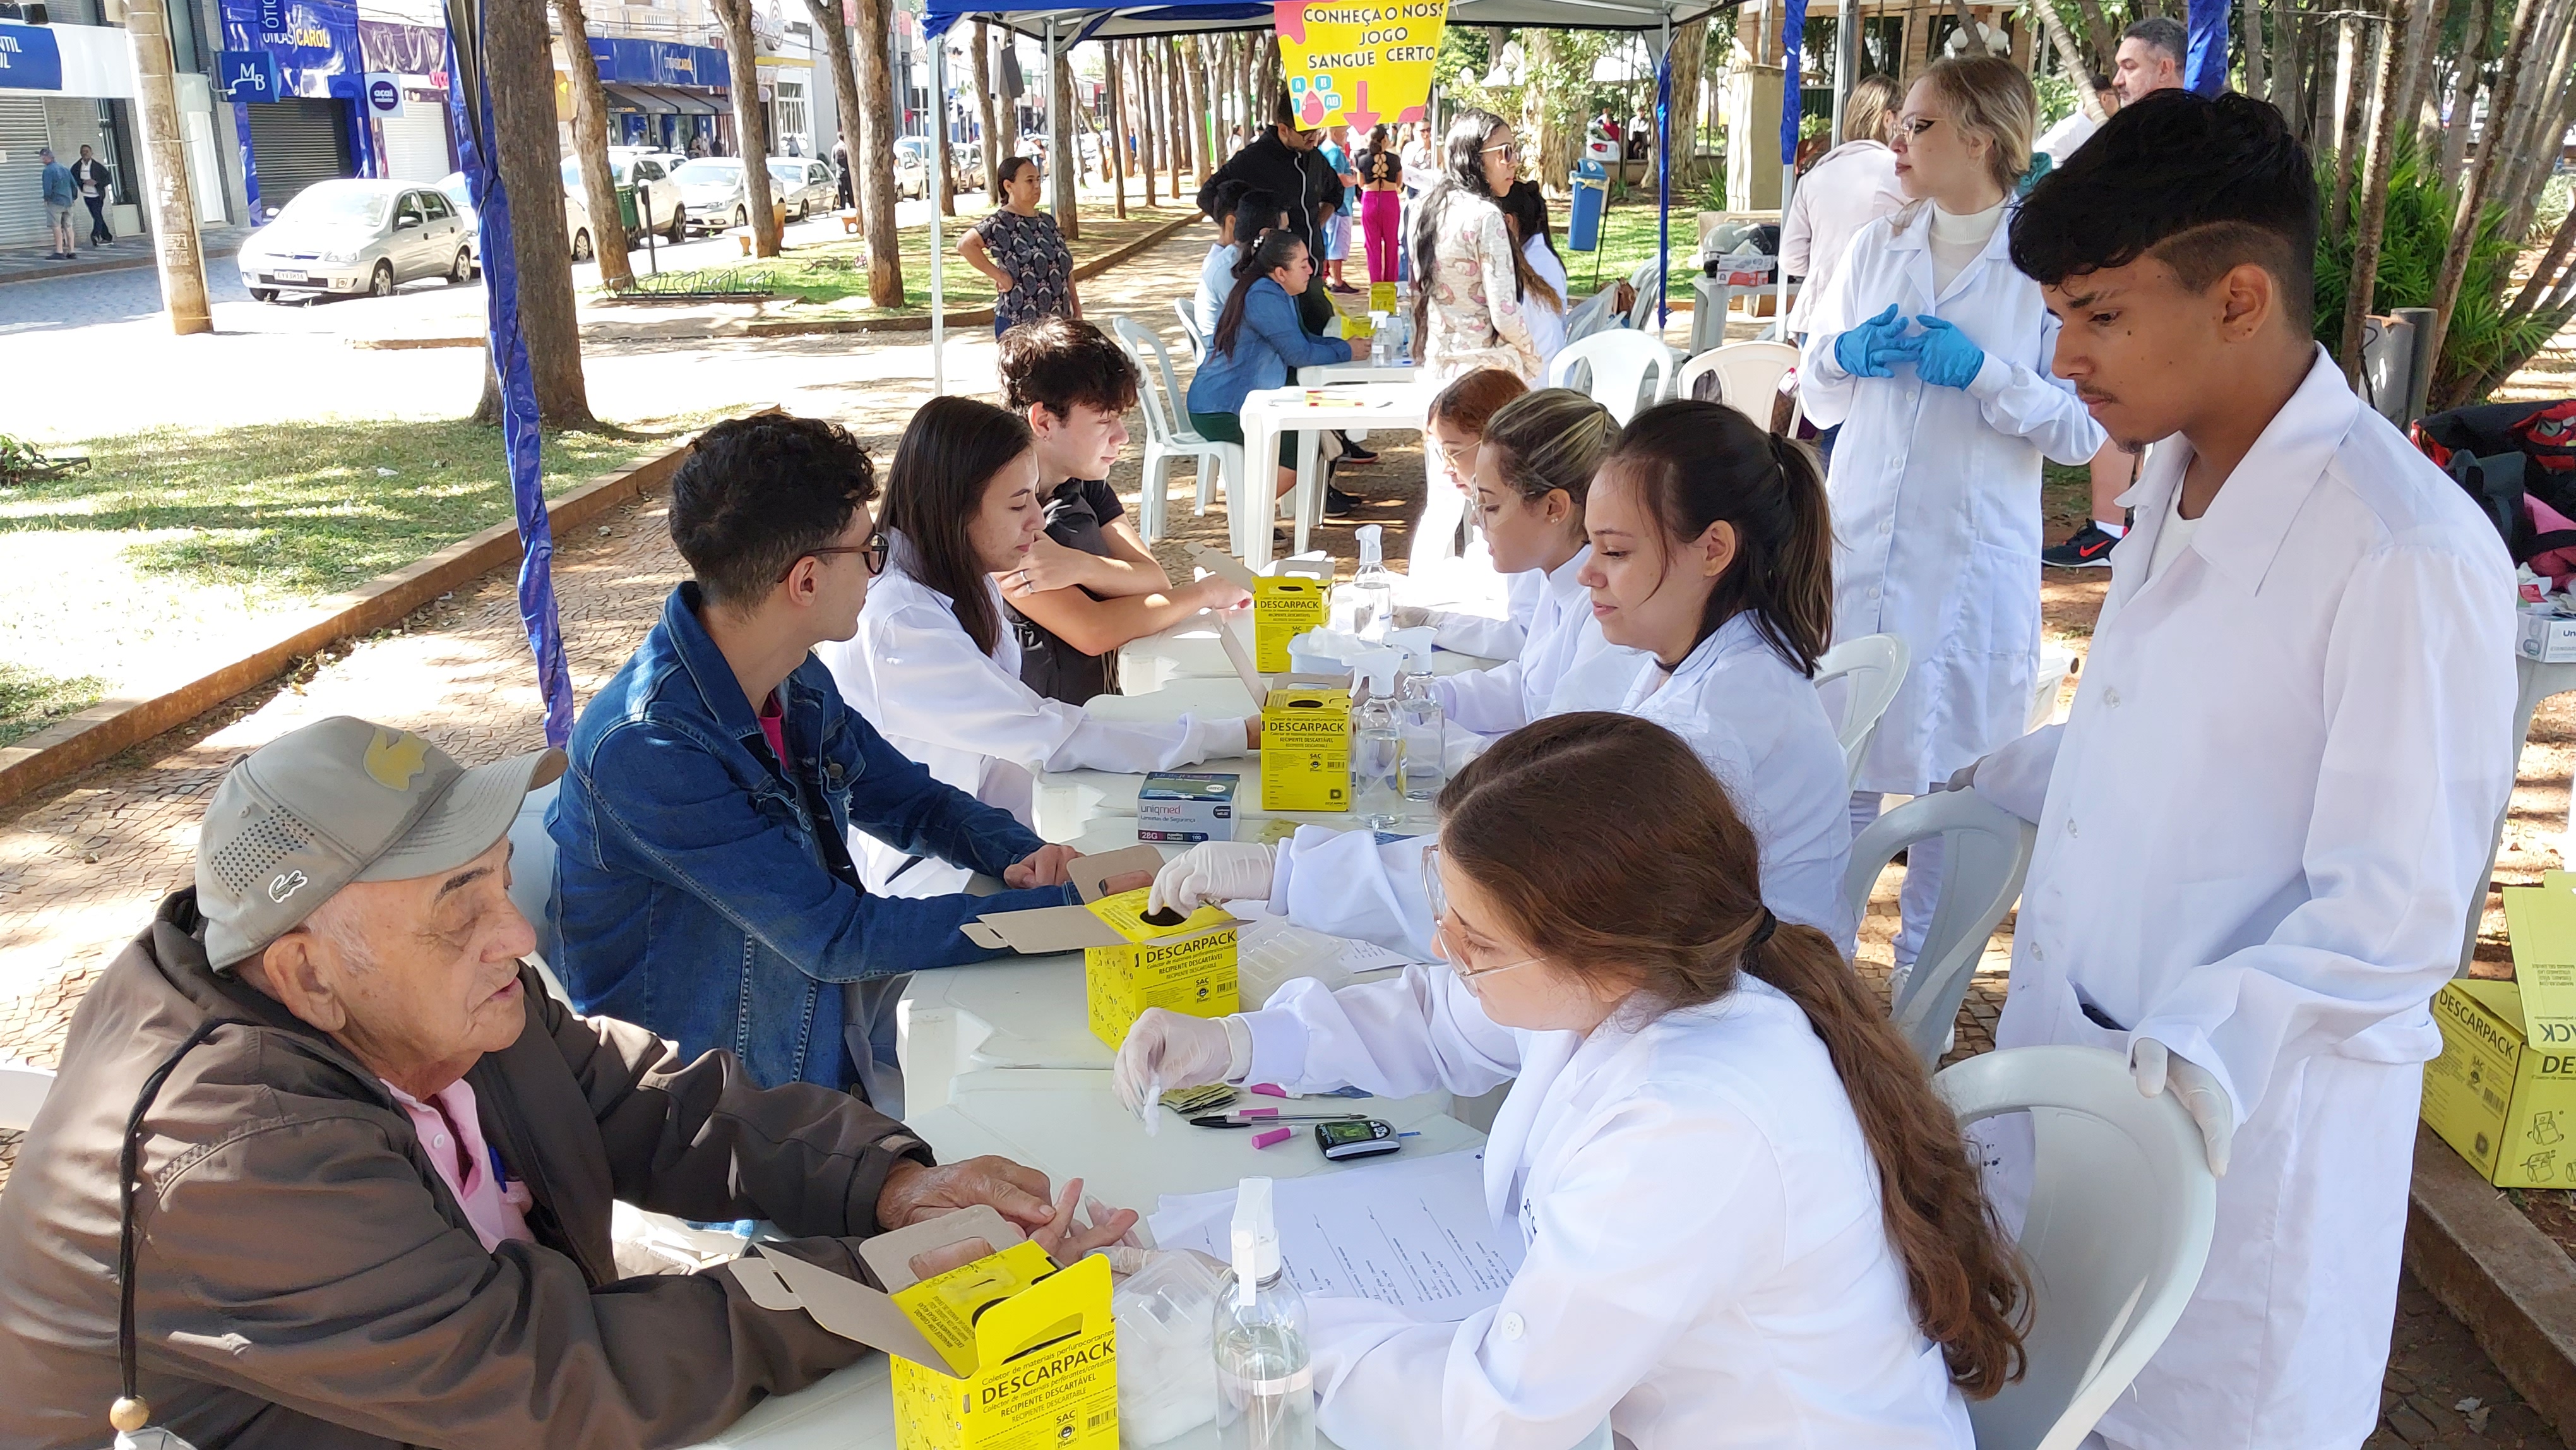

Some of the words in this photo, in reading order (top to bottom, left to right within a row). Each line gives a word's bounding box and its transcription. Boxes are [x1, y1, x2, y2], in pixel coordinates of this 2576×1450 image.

[1304, 8, 1382, 27] CONHEÇA
[1385, 7, 1397, 20] O
[296, 28, 330, 48] CAROL
[1359, 27, 1408, 45] JOGO
[1309, 52, 1375, 68] SANGUE
[1386, 46, 1435, 62] CERTO
[1260, 601, 1319, 609] DESCARPACK
[1270, 722, 1344, 732] DESCARPACK
[1141, 805, 1181, 815] uniqmed
[1147, 930, 1236, 963] DESCARPACK
[1159, 963, 1188, 974] RECIPIENTE
[1189, 953, 1222, 967] DESCARTÁVEL
[1196, 977, 1209, 986] SAC
[2439, 988, 2514, 1062] DESCARPACK
[982, 1370, 1010, 1386] Coletor
[1013, 1366, 1021, 1375] de
[1023, 1353, 1055, 1370] materiais
[1057, 1329, 1115, 1357] perfurocortantes
[982, 1337, 1115, 1405] DESCARPACK
[983, 1399, 1010, 1413] Colector
[1021, 1384, 1049, 1398] materiais
[1001, 1395, 1042, 1418] RECIPIENTE
[1045, 1372, 1097, 1399] DESCARTÁVEL
[1012, 1404, 1045, 1423] RECIPIENTE
[1046, 1387, 1087, 1410] DESCARTABLE
[1056, 1410, 1076, 1424] SAC
